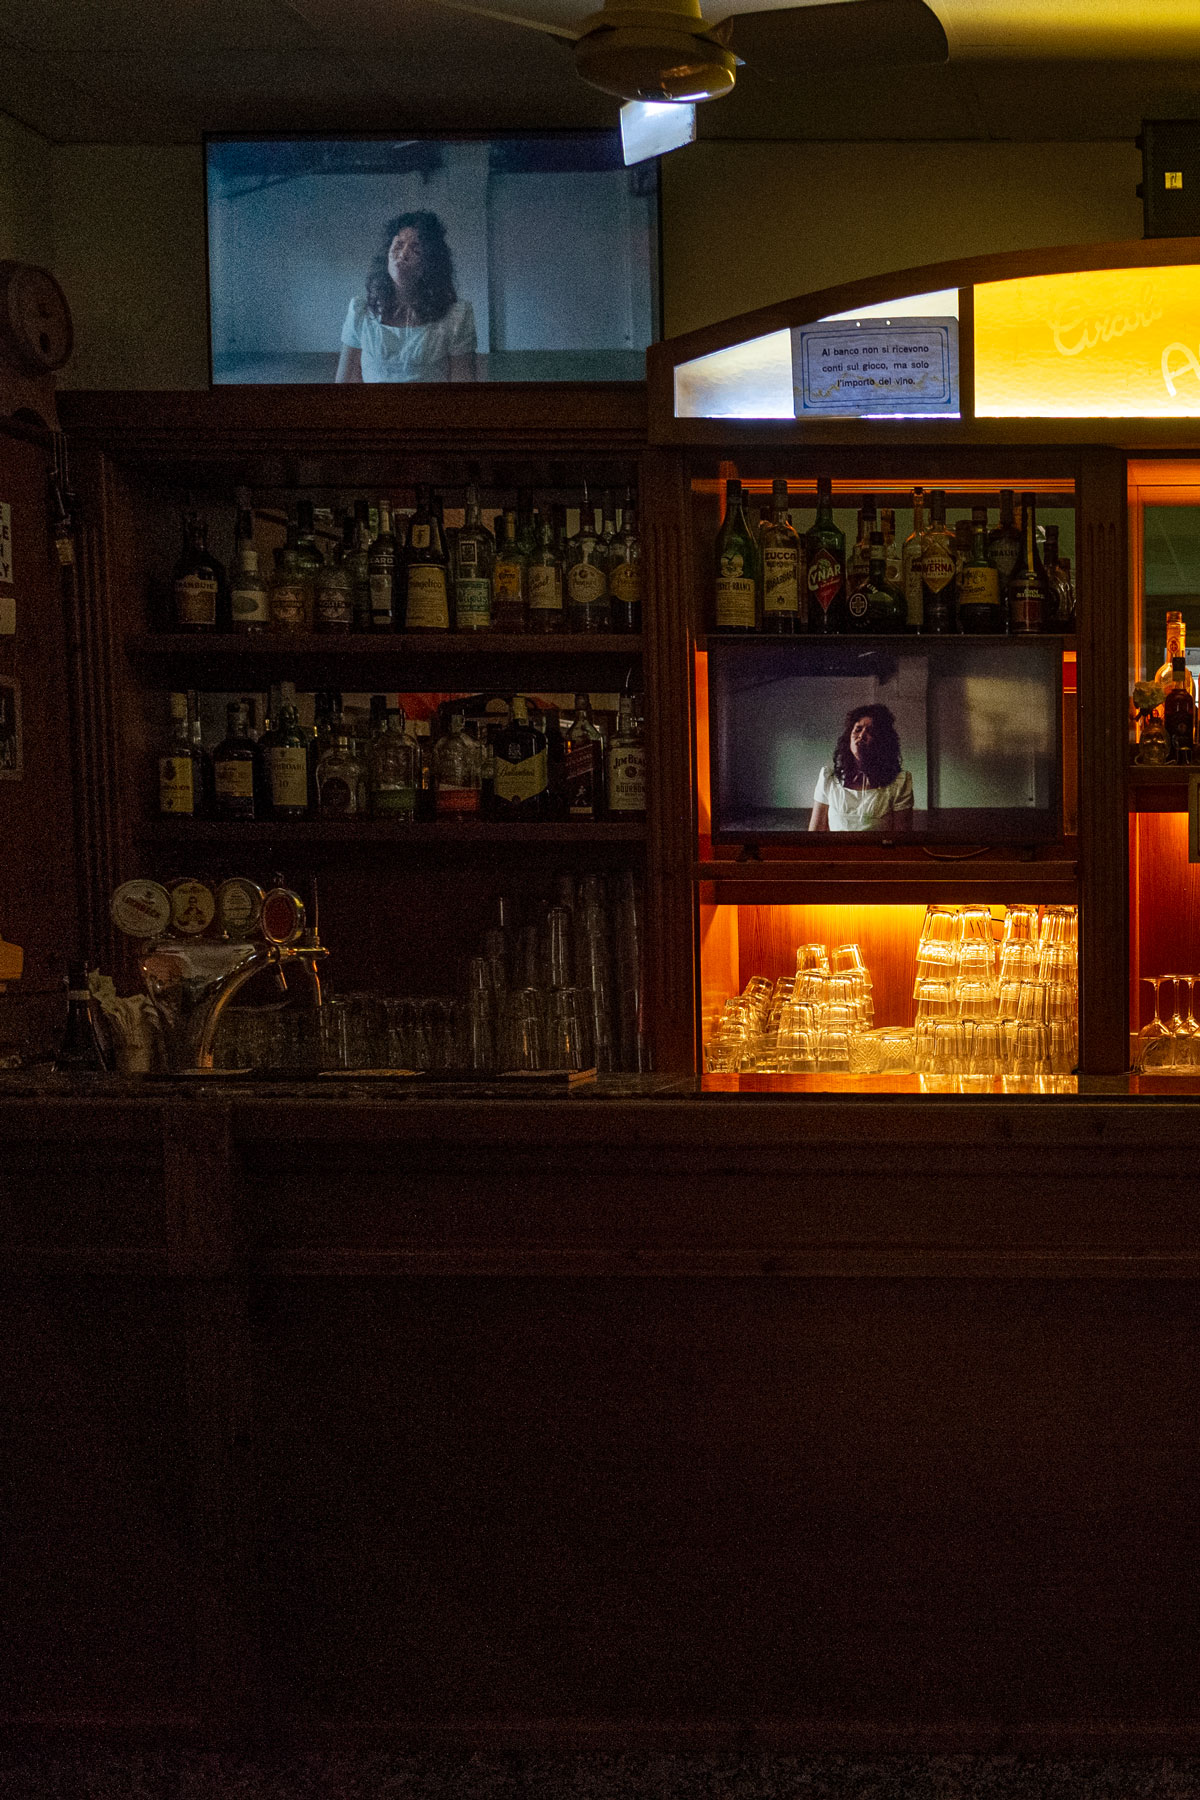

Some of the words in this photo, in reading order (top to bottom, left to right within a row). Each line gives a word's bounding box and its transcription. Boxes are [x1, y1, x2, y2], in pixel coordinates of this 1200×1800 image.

[822, 348, 830, 356] Al
[833, 347, 859, 356] banco
[882, 345, 889, 354] si
[892, 345, 929, 354] ricevono
[822, 362, 843, 372] conti
[847, 362, 859, 371] sul
[862, 361, 888, 372] gioco,
[893, 362, 907, 370] ma
[911, 360, 929, 369] solo
[837, 379, 875, 388] l'importo
[879, 377, 892, 385] del
[896, 377, 915, 385] vino.
[765, 552, 796, 561] ZUCCA
[808, 563, 841, 592] CYNAR
[613, 757, 628, 769] JIM
